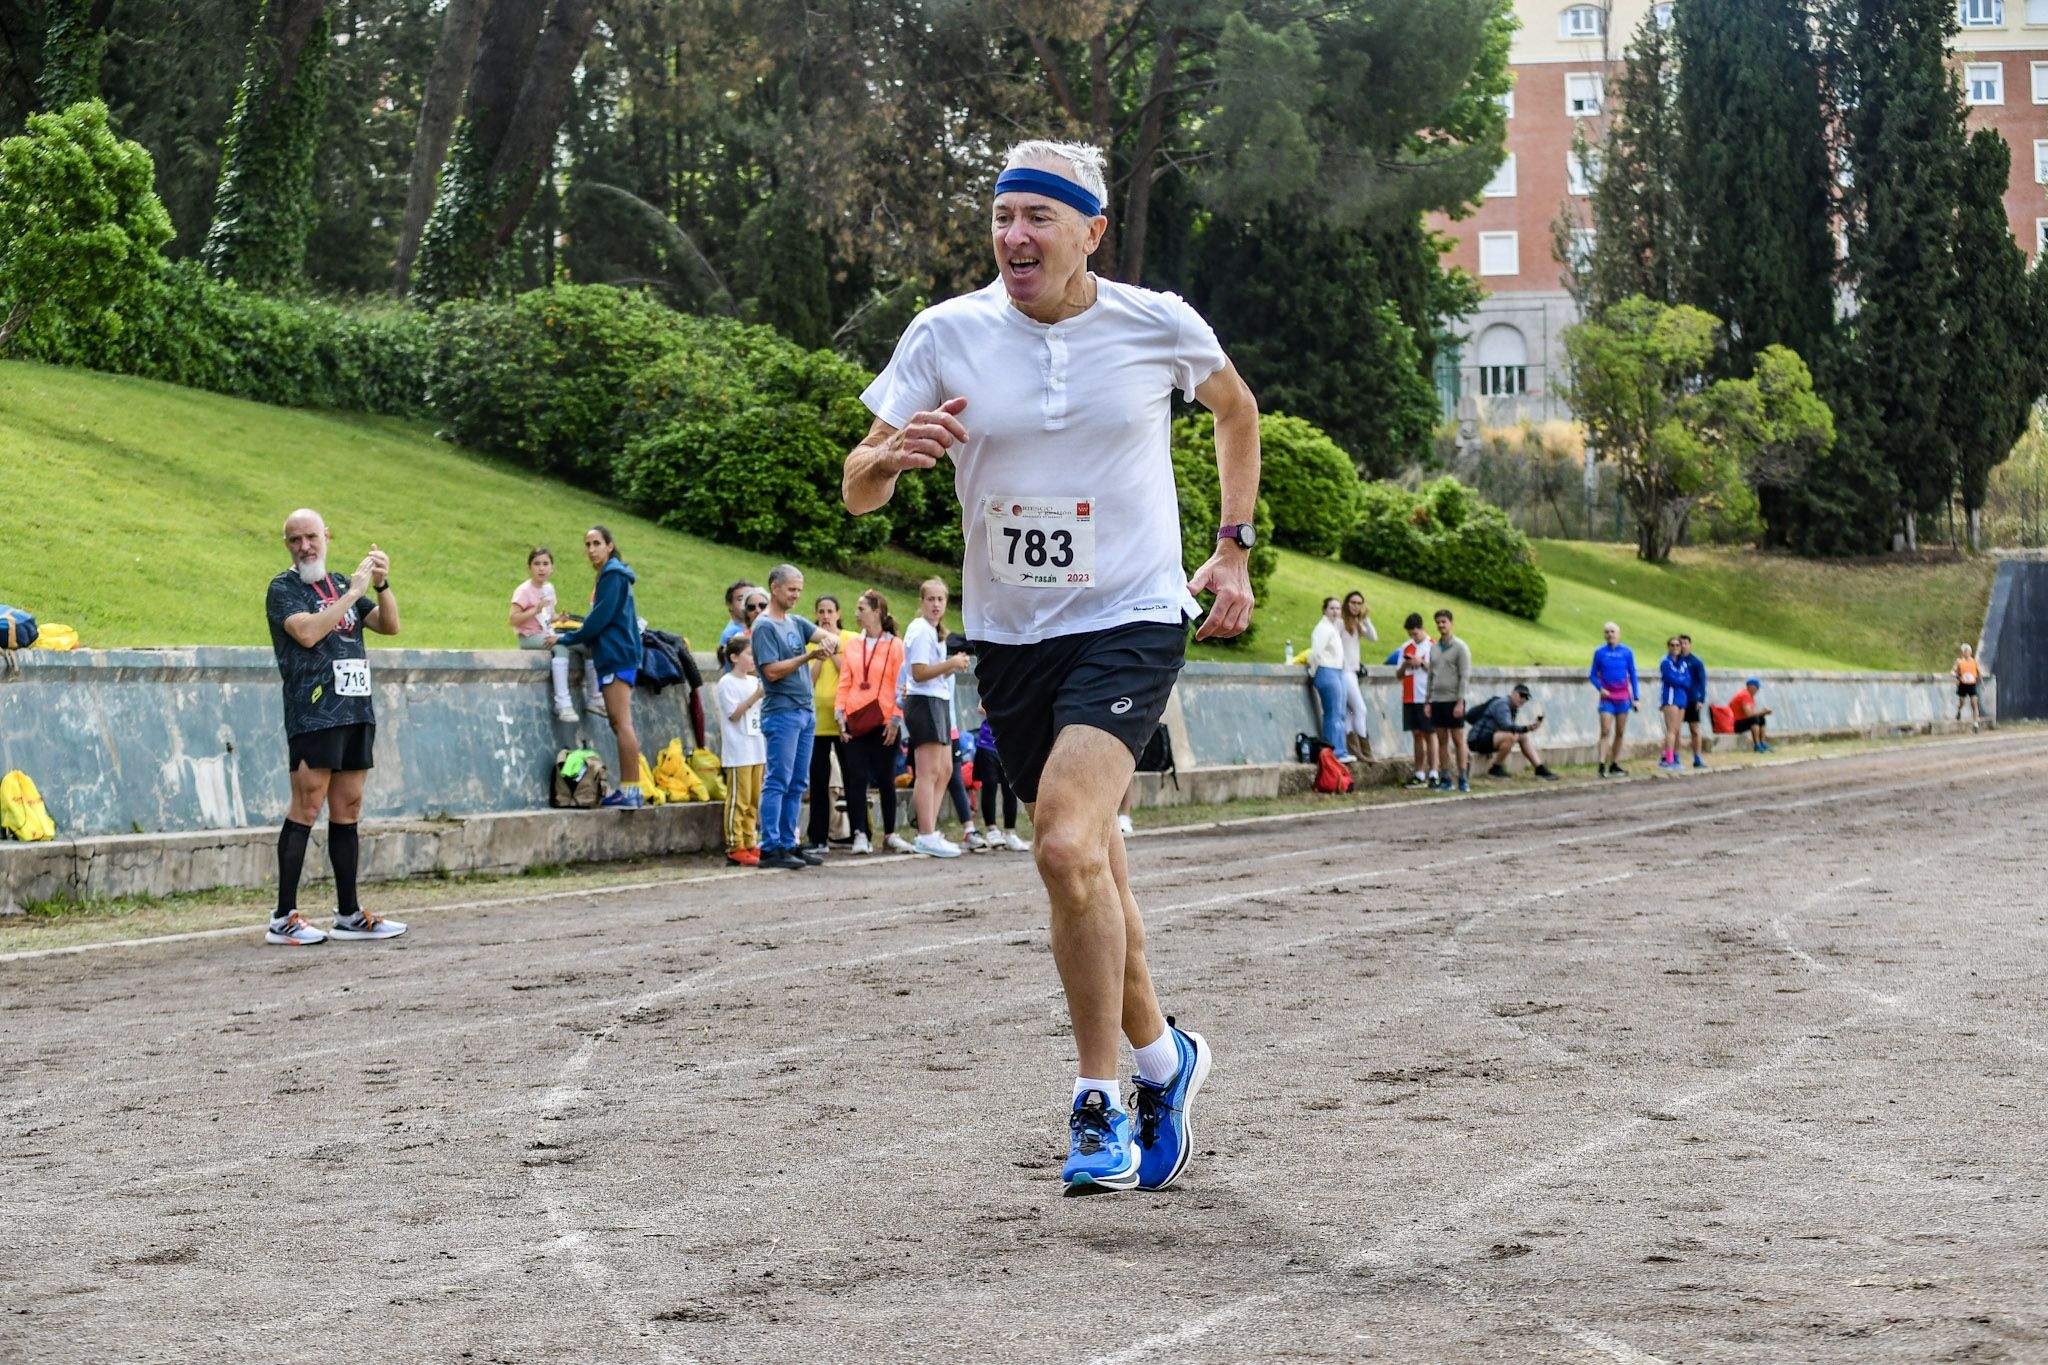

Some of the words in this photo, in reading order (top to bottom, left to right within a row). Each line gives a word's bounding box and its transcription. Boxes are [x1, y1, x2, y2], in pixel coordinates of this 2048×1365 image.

[1003, 527, 1074, 568] 783
[1067, 573, 1090, 582] 2023
[343, 672, 366, 687] 718
